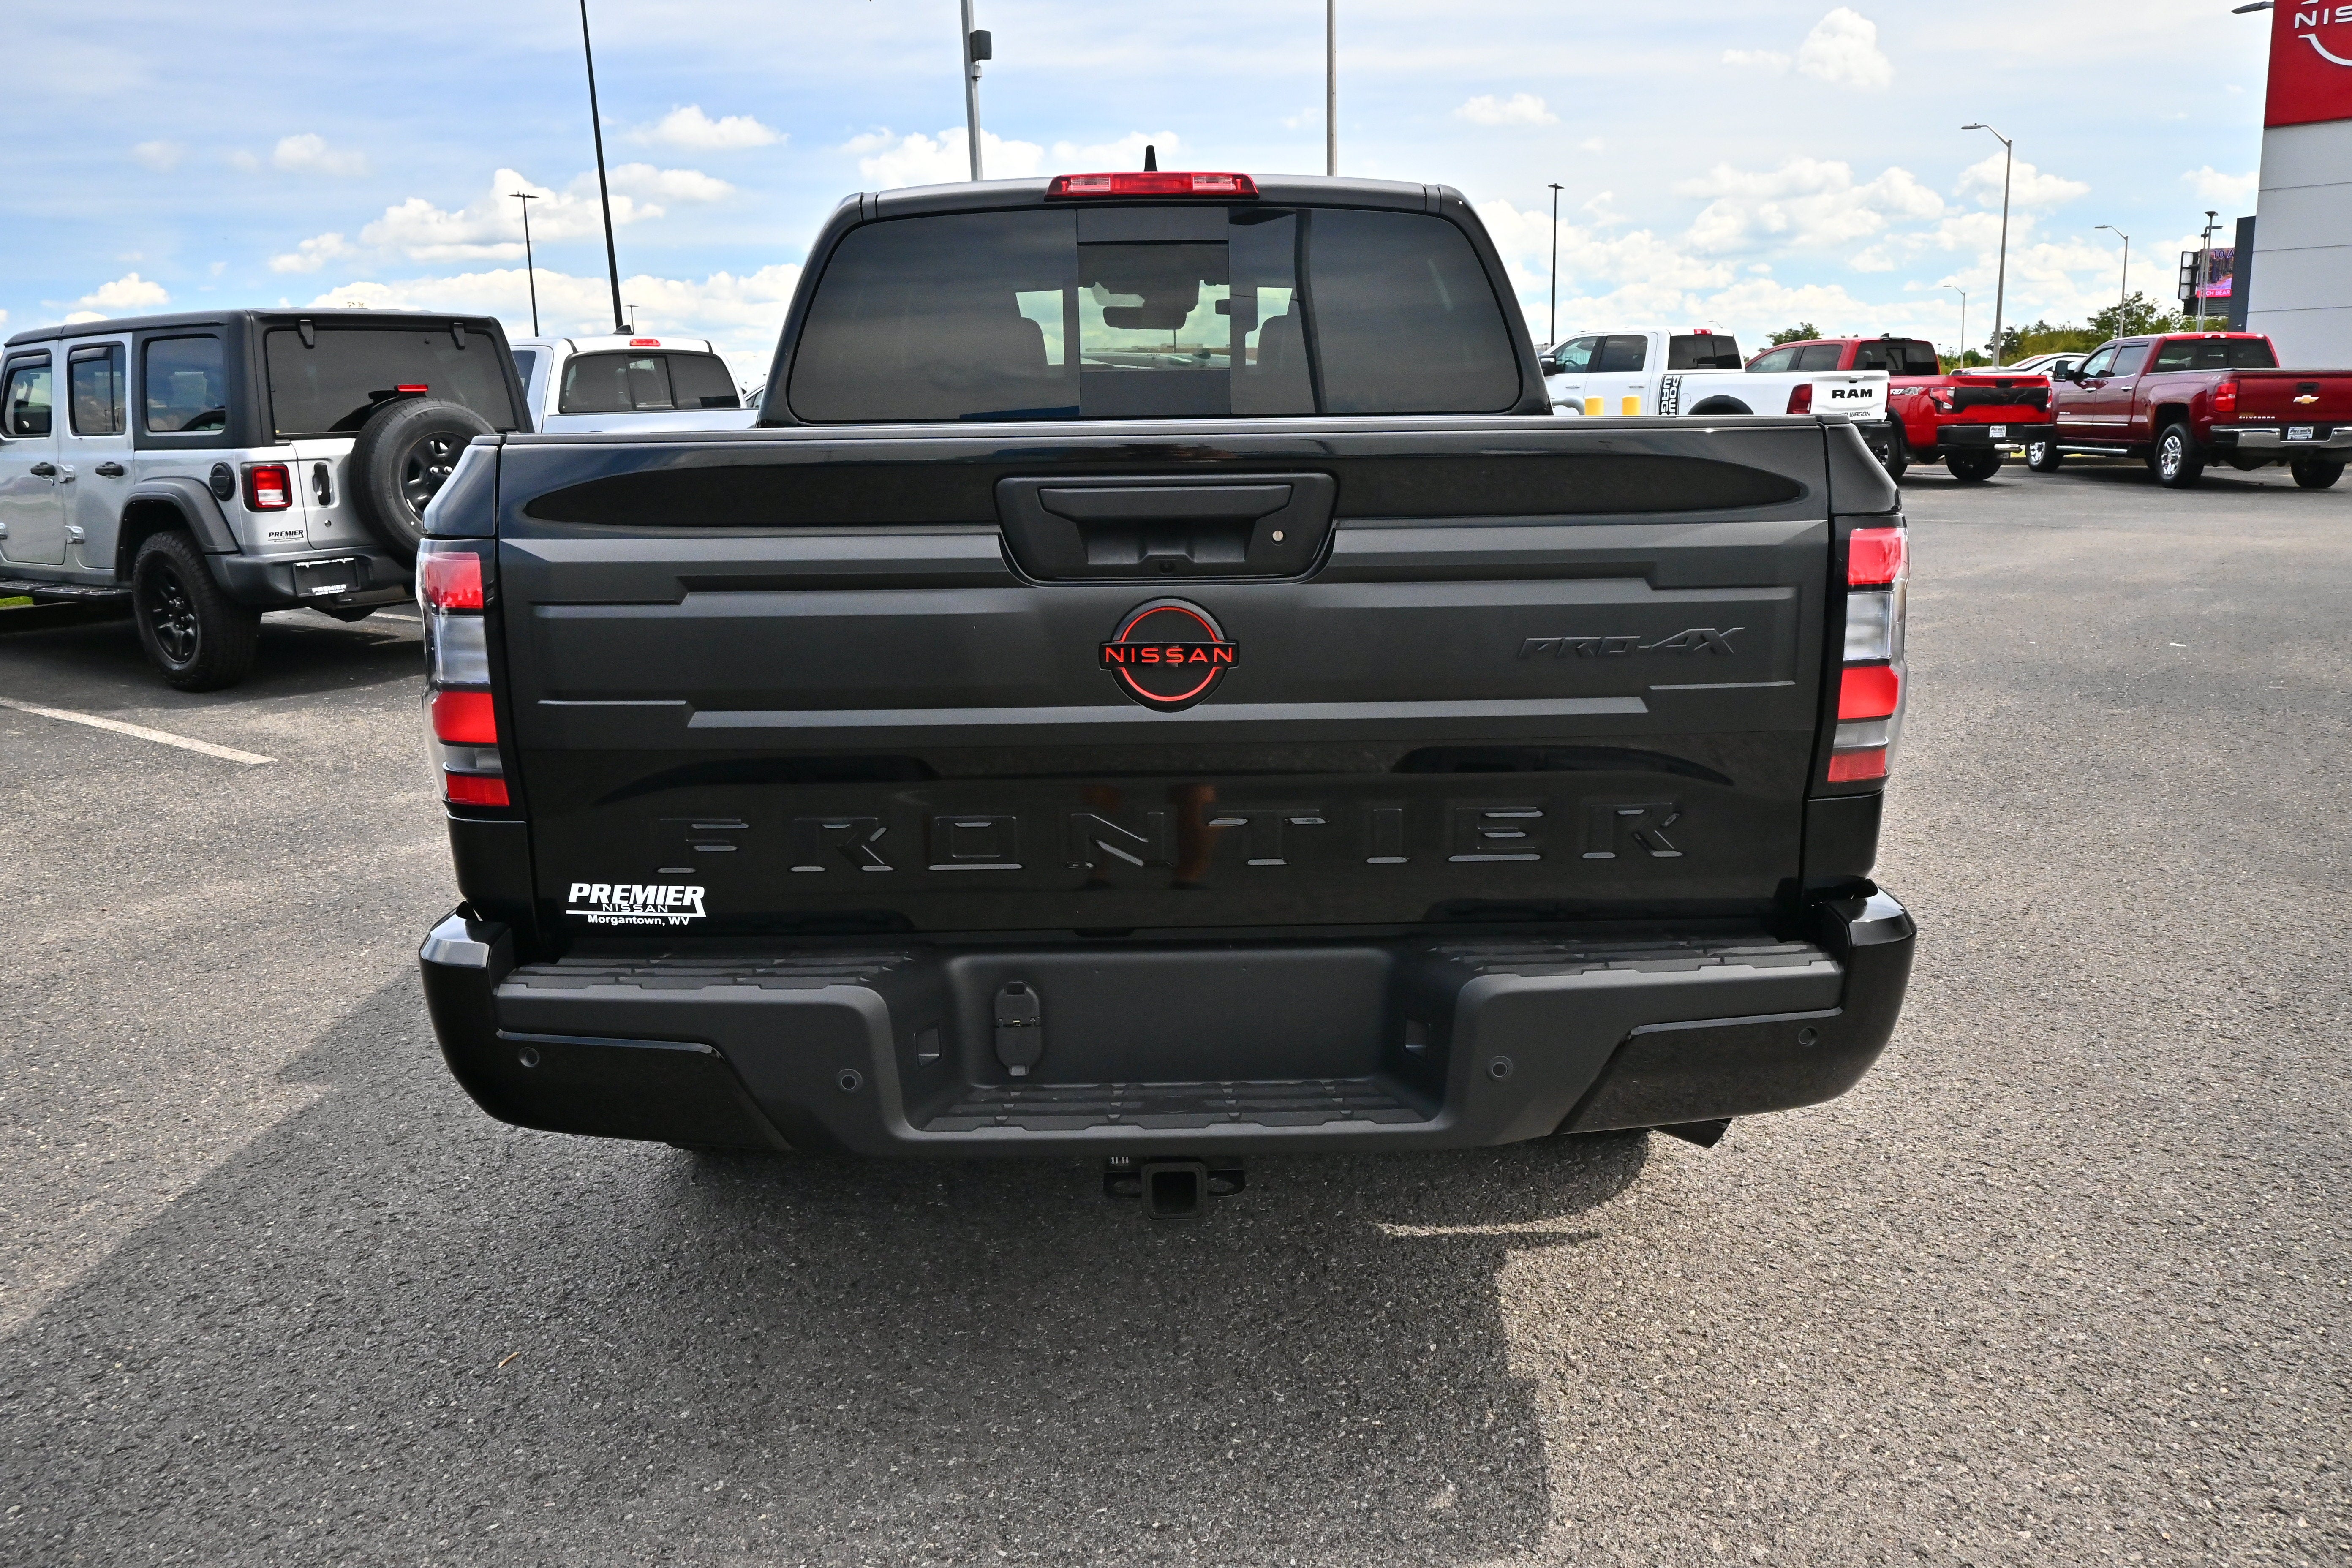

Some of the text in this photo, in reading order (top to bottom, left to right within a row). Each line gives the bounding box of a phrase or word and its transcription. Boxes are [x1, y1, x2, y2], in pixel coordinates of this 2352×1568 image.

[2295, 5, 2352, 29] NIS
[2214, 250, 2224, 259] 10
[1661, 375, 1673, 415] WAG
[1669, 375, 1681, 415] POW
[1832, 389, 1872, 398] RAM
[268, 530, 304, 538] PREMIER
[1518, 627, 1746, 657] PRO-4X
[1105, 647, 1232, 663] NISSAN
[656, 803, 1684, 874] FRONTIER
[568, 883, 706, 909] PREMIER
[602, 903, 668, 913] NISSAN
[588, 915, 690, 926] Morgantown, WV
